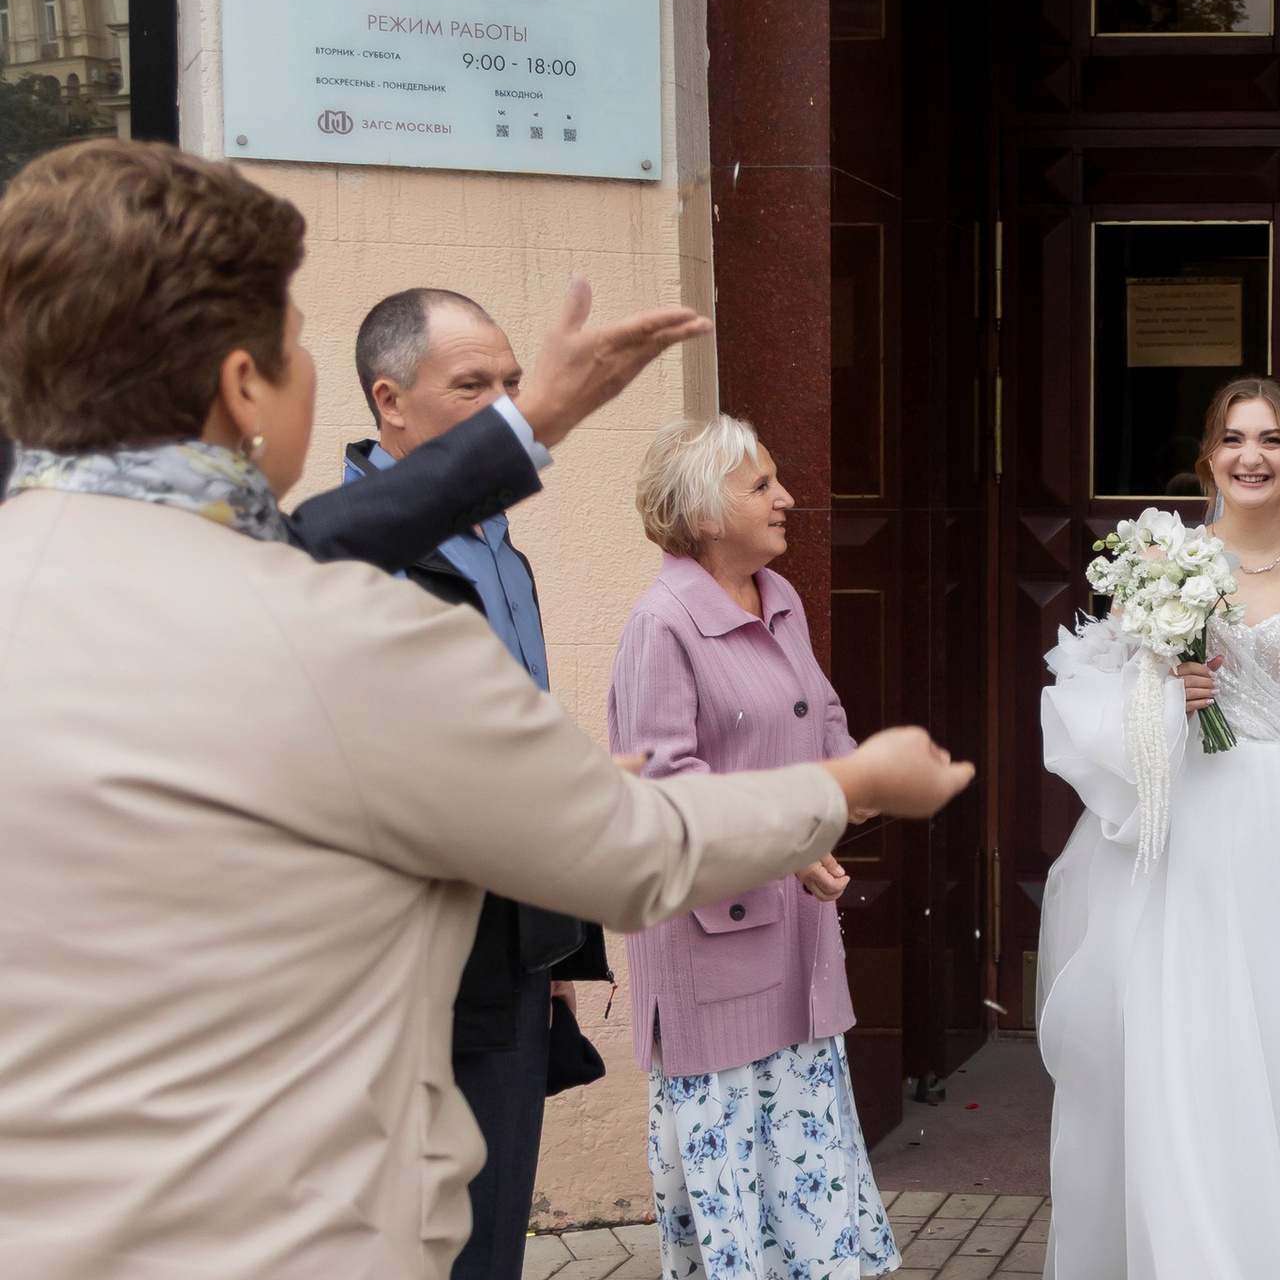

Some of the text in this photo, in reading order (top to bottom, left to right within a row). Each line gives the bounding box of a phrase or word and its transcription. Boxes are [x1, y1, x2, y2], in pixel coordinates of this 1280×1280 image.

[367, 14, 527, 42] РЕЖИМ РАБОТЫ
[315, 47, 355, 57] ВТОРНИК
[362, 50, 402, 60] СУББОТА
[462, 52, 505, 71] 9:00
[527, 57, 576, 76] 18:00
[316, 76, 376, 88] ВОСКРЕСЕНЬЕ
[382, 81, 447, 93] ПОНЕДЕЛЬНИК
[494, 89, 544, 100] ВЫХОДНОЙ
[361, 119, 452, 135] ЗАГС МОСКВЫ
